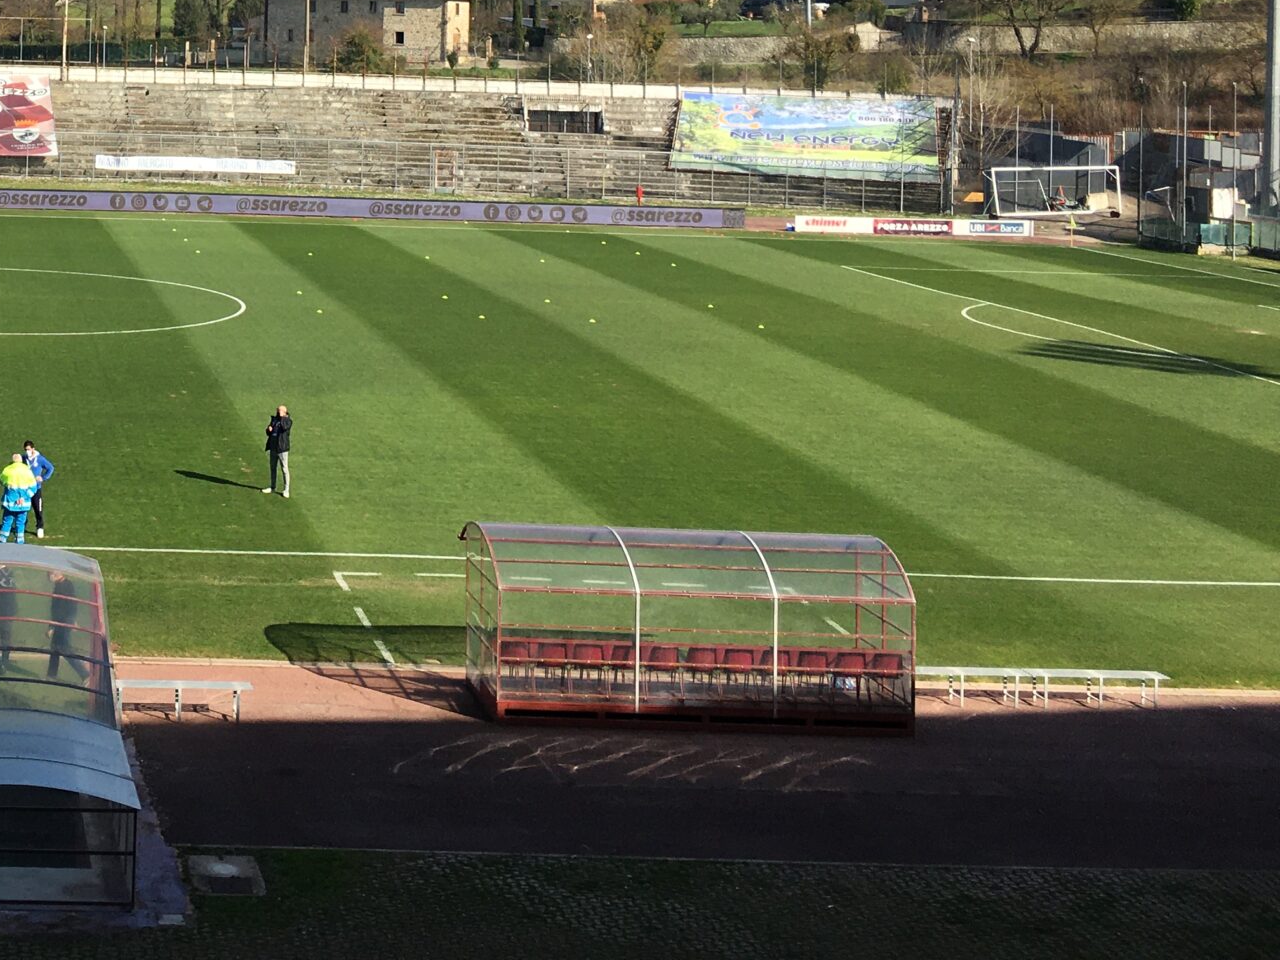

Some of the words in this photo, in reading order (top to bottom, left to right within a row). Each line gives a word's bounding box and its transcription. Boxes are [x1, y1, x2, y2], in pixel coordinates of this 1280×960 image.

[236, 197, 328, 213] @ssarezzo
[369, 201, 461, 217] @ssarezzo
[611, 208, 703, 224] @ssarezzo
[805, 218, 847, 228] chimet
[877, 222, 908, 230] FORZA
[910, 223, 950, 232] AREZZO
[970, 223, 985, 232] UBI
[1000, 224, 1024, 233] Banca
